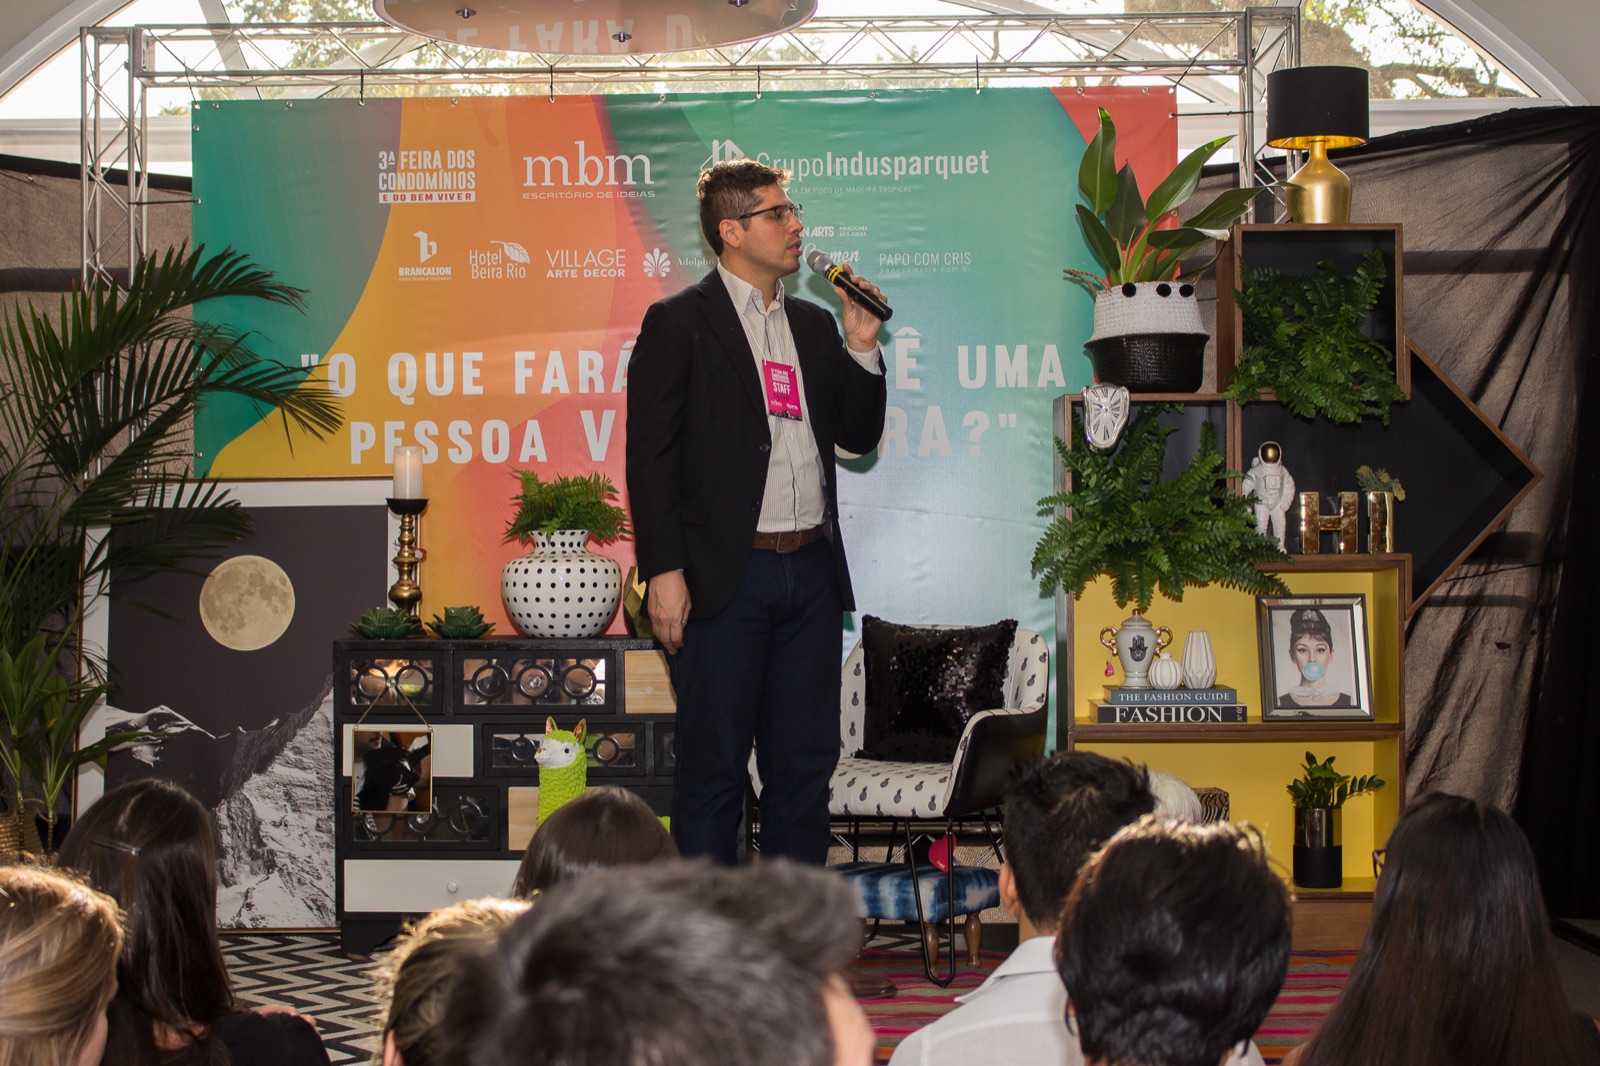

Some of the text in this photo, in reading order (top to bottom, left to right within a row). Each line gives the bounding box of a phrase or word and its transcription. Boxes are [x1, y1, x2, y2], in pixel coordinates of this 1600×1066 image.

[400, 150, 443, 170] FEIRA
[447, 149, 475, 169] DOS
[522, 140, 655, 187] mbm
[378, 168, 476, 191] CONDOMÍNIOS
[382, 192, 472, 202] E DO BEM VIVER
[522, 190, 656, 200] ESCRITÓRIO DE IDEIAS
[810, 226, 835, 237] ARTS
[469, 248, 502, 266] Hotel
[545, 248, 626, 268] VILLAGE
[676, 257, 714, 269] Adolpho
[879, 252, 971, 267] PAPO COM CRIS
[398, 266, 452, 276] BRANCALION
[471, 263, 526, 279] Beira Rio
[546, 269, 626, 279] ARTE DECOR
[387, 351, 484, 406] QUE
[957, 344, 1066, 389] UMA
[772, 381, 791, 395] STAFF
[350, 418, 548, 465] PESSOA
[1118, 692, 1230, 702] THE FASHION GUIDE
[1113, 706, 1224, 723] FASHION
